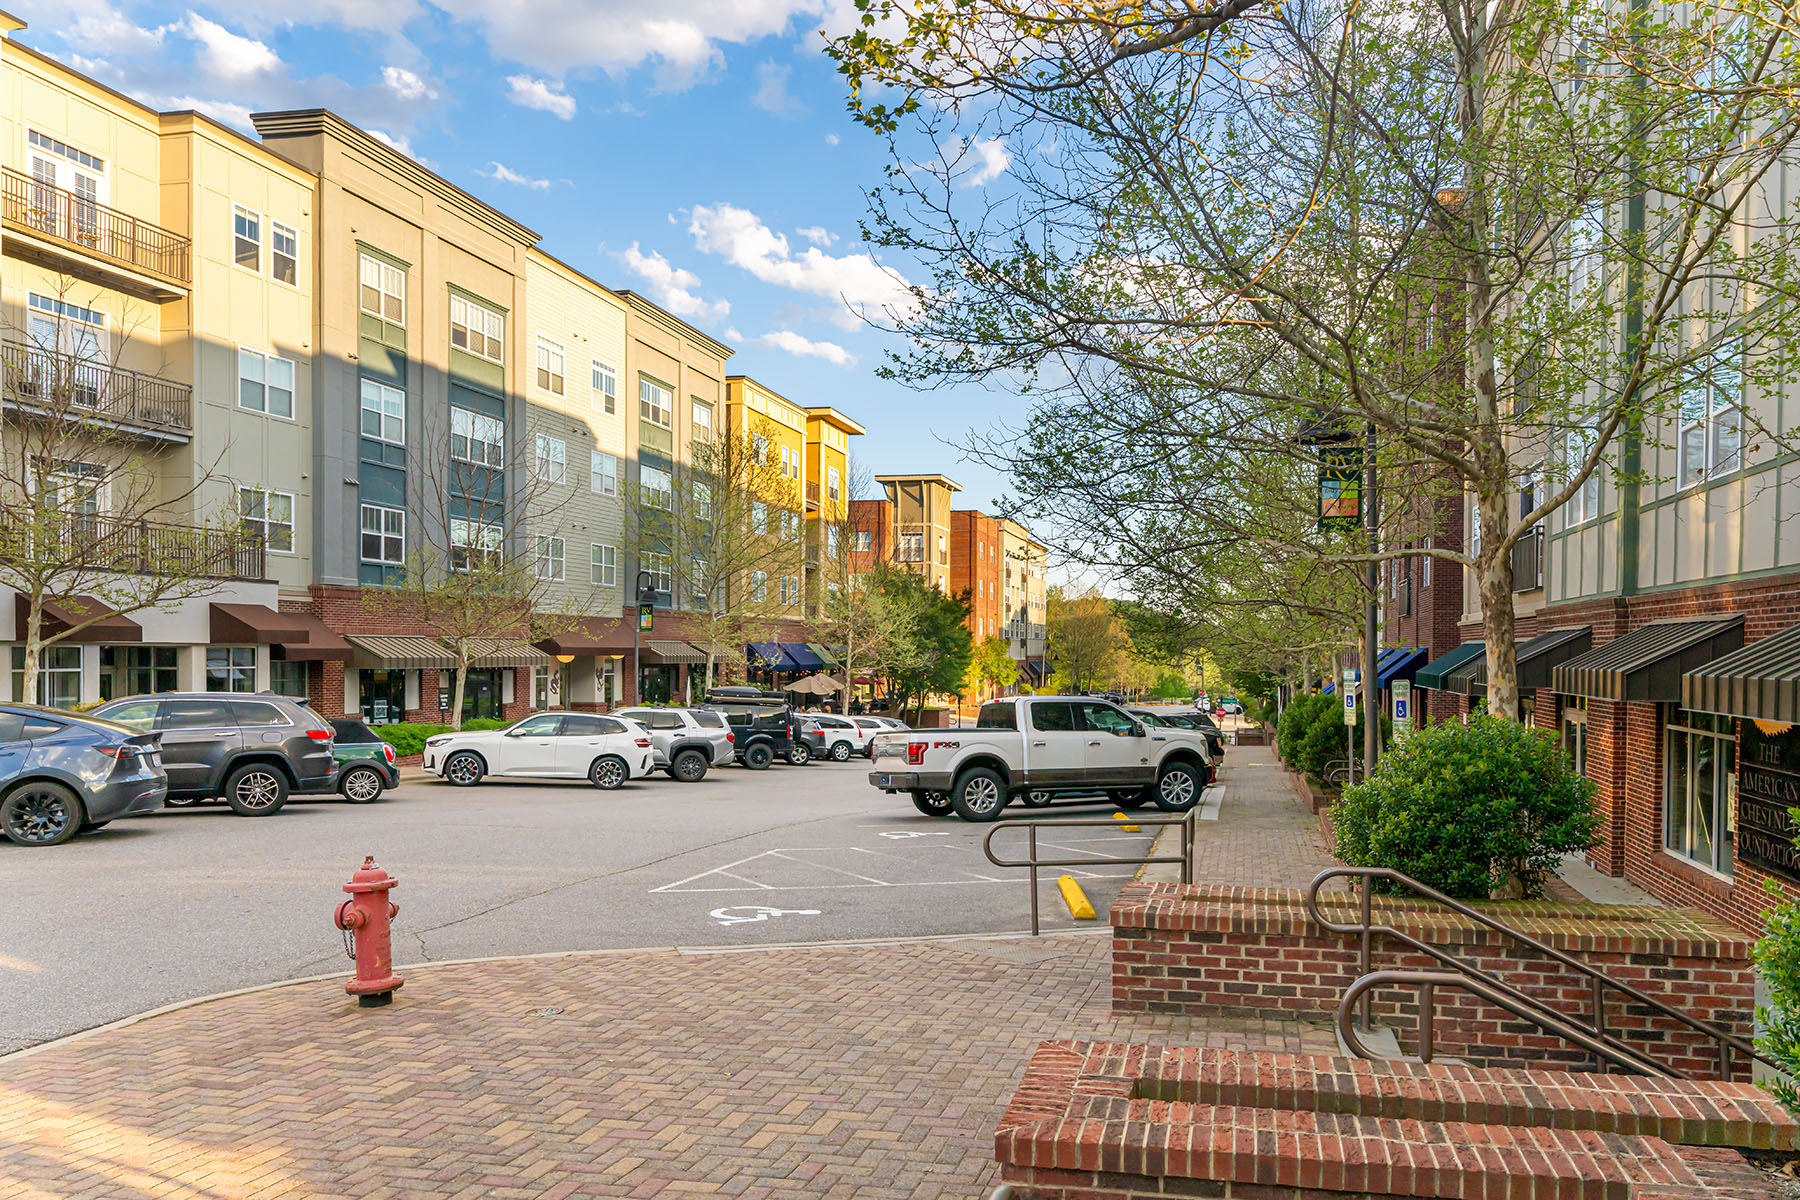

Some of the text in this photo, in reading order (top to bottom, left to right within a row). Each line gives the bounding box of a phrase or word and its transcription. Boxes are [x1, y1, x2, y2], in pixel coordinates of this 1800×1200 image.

[933, 741, 960, 750] FX4
[1759, 742, 1781, 765] THE
[1742, 771, 1799, 801] AMERICAN
[1738, 831, 1800, 870] OUNDATIO
